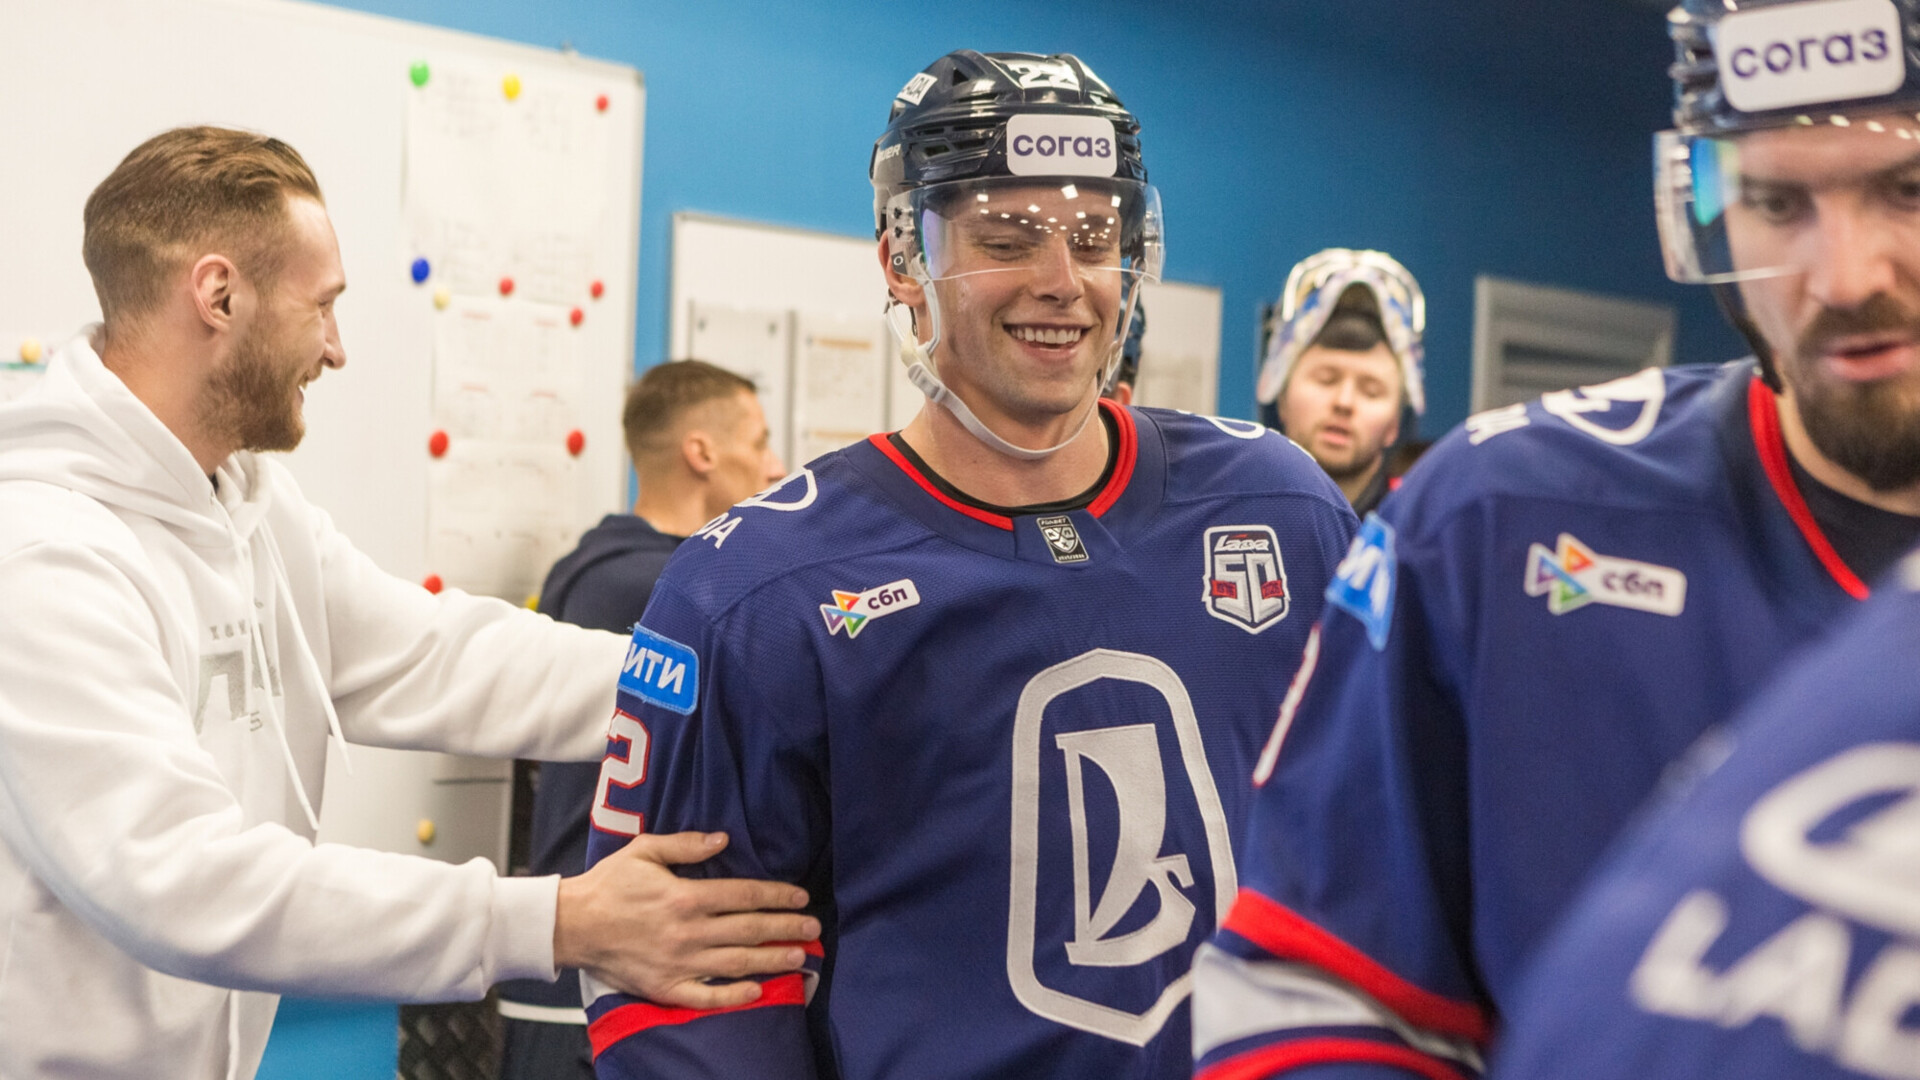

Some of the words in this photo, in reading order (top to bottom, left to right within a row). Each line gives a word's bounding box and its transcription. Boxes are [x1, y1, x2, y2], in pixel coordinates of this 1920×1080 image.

[1731, 28, 1889, 78] согаз
[1012, 134, 1112, 158] согаз
[1602, 570, 1664, 600] сбп
[867, 588, 908, 610] сбп
